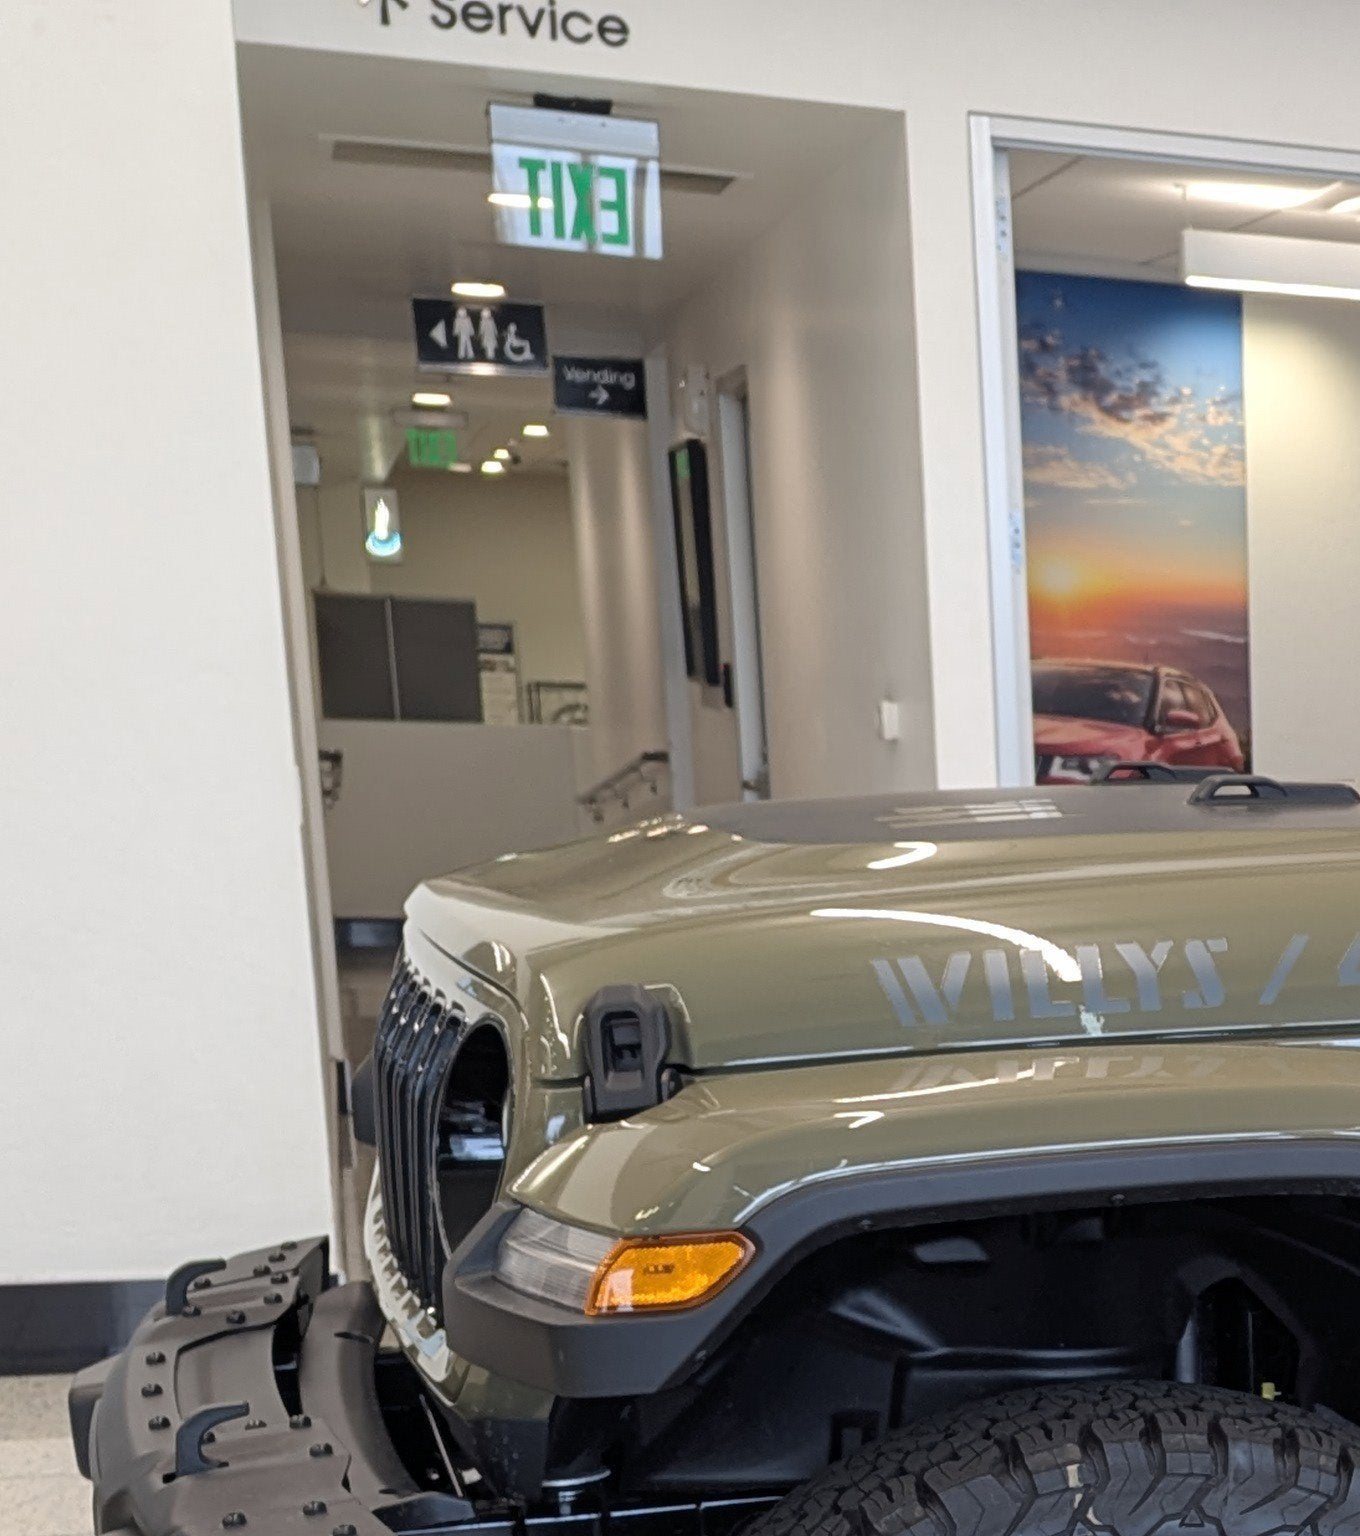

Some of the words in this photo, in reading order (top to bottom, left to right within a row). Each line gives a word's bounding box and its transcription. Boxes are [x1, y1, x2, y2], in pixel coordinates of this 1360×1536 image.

[430, 0, 630, 47] Service
[562, 364, 636, 391] Vending
[871, 937, 1228, 1027] WILLYS
